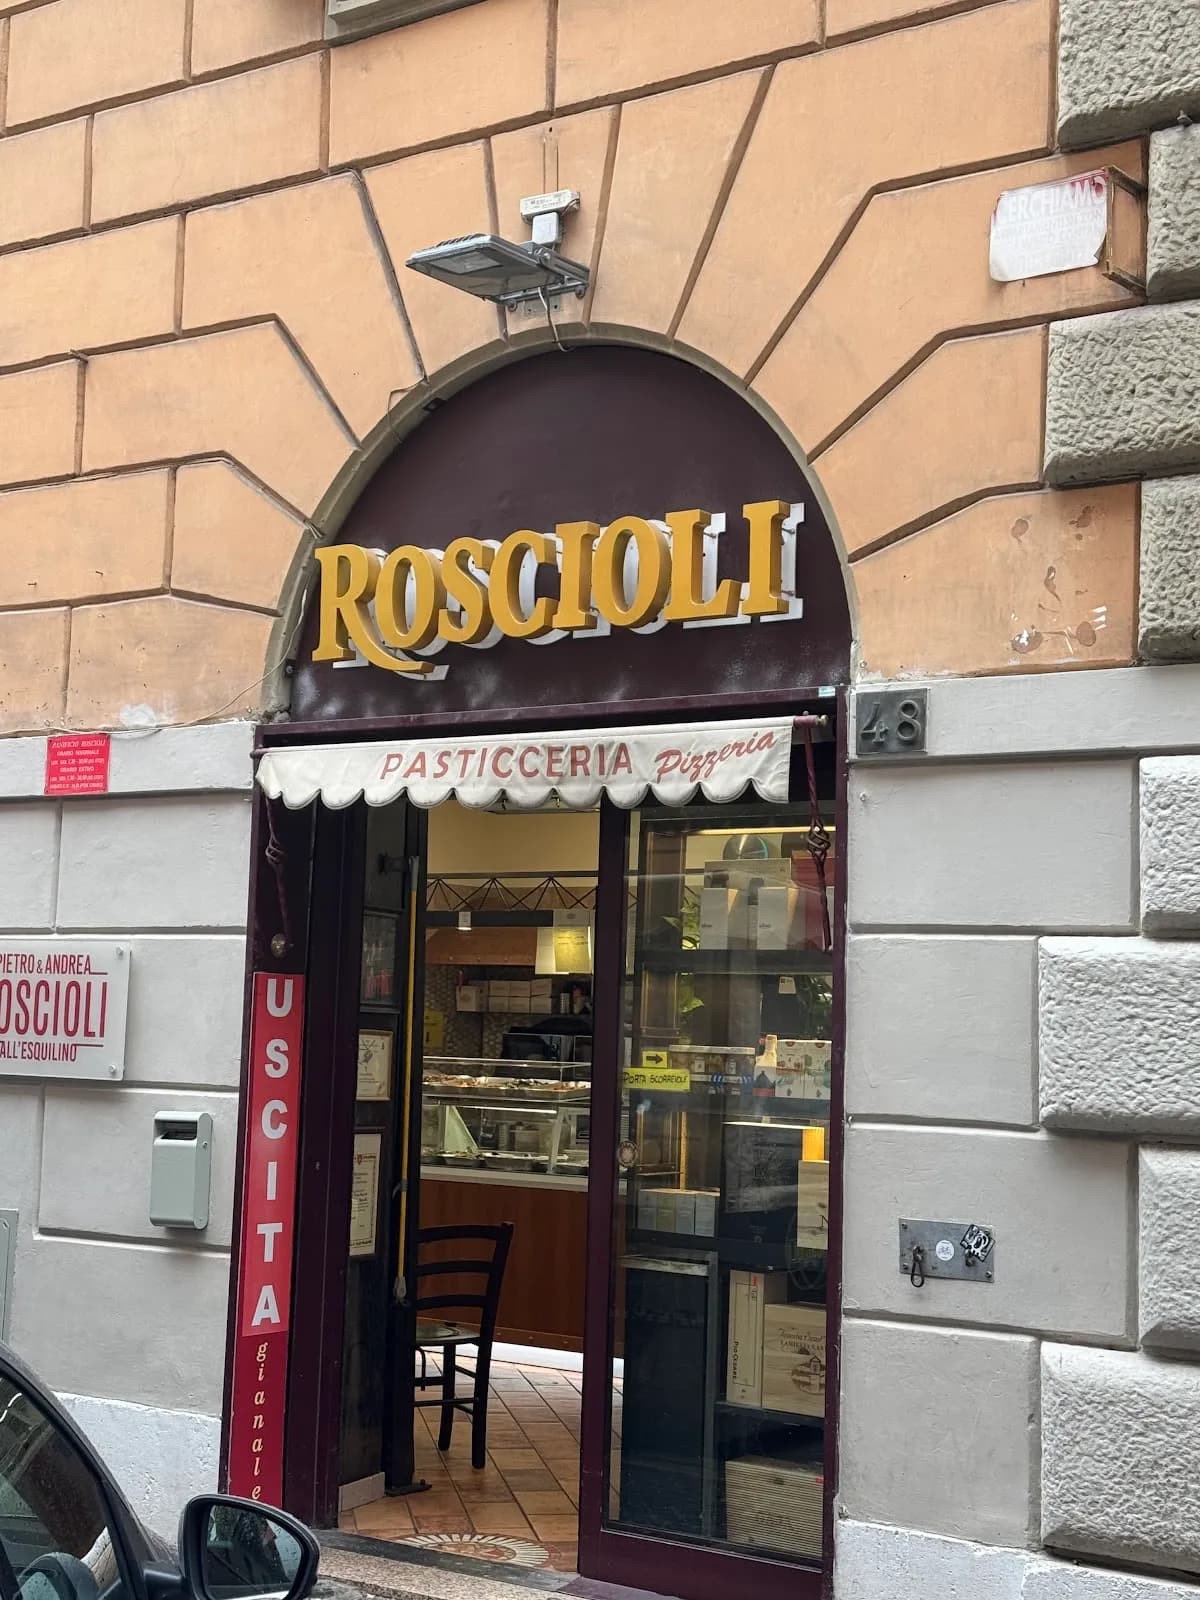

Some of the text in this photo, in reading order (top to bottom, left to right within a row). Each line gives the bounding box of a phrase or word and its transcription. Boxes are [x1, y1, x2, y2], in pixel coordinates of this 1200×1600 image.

[312, 500, 795, 677] ROSCIOLI
[861, 700, 921, 743] 48
[380, 730, 778, 783] PASTICCERIA Pizzeria
[36, 960, 43, 974] &
[45, 954, 91, 975] ANDREA
[250, 978, 294, 1327] USCITA
